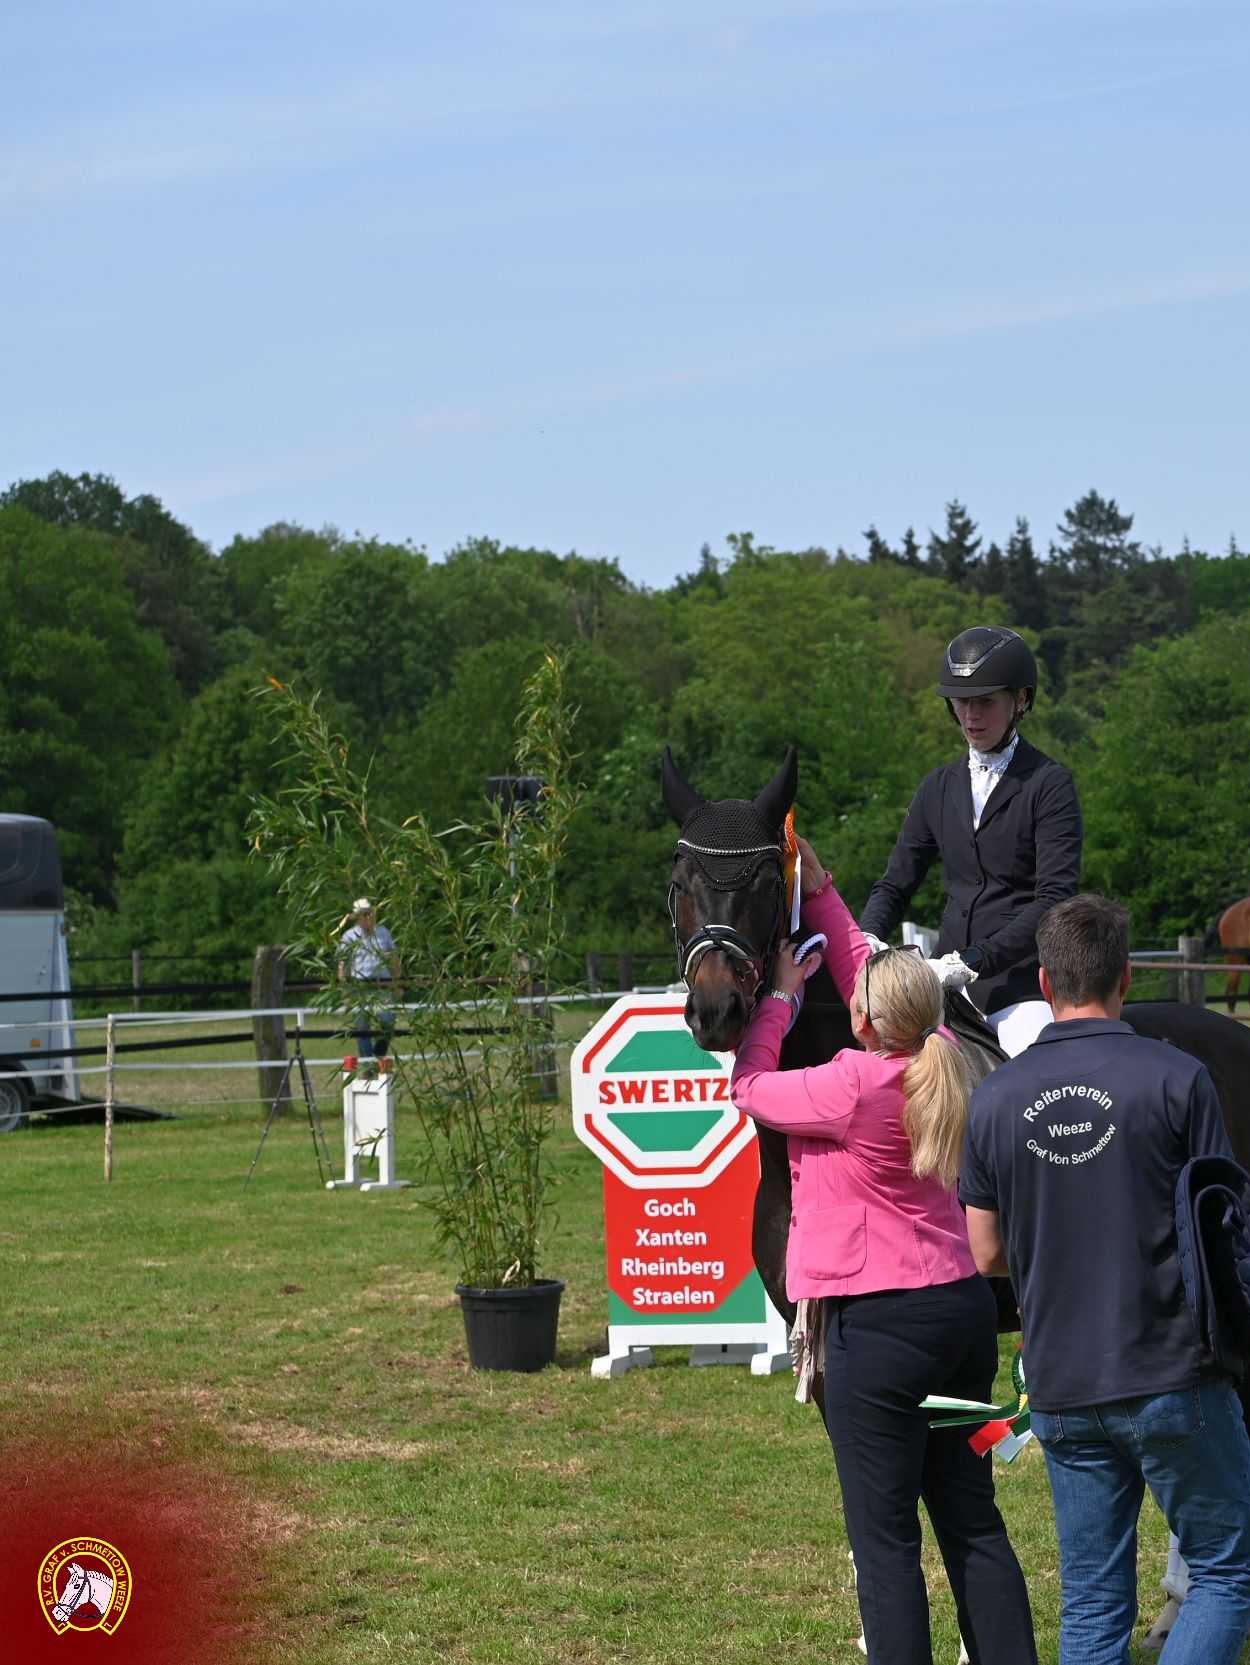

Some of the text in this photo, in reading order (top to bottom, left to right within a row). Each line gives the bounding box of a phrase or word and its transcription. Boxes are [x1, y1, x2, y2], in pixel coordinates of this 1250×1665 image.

[598, 1077, 730, 1105] SWERTZ
[1023, 1085, 1113, 1122] Reiterverein
[1048, 1121, 1093, 1138] Weeze
[1026, 1123, 1116, 1165] Graf Von Schmettow
[644, 1198, 696, 1218] Goch
[635, 1228, 707, 1248] Xanten
[621, 1257, 725, 1280] Rheinberg
[633, 1287, 715, 1306] Straelen
